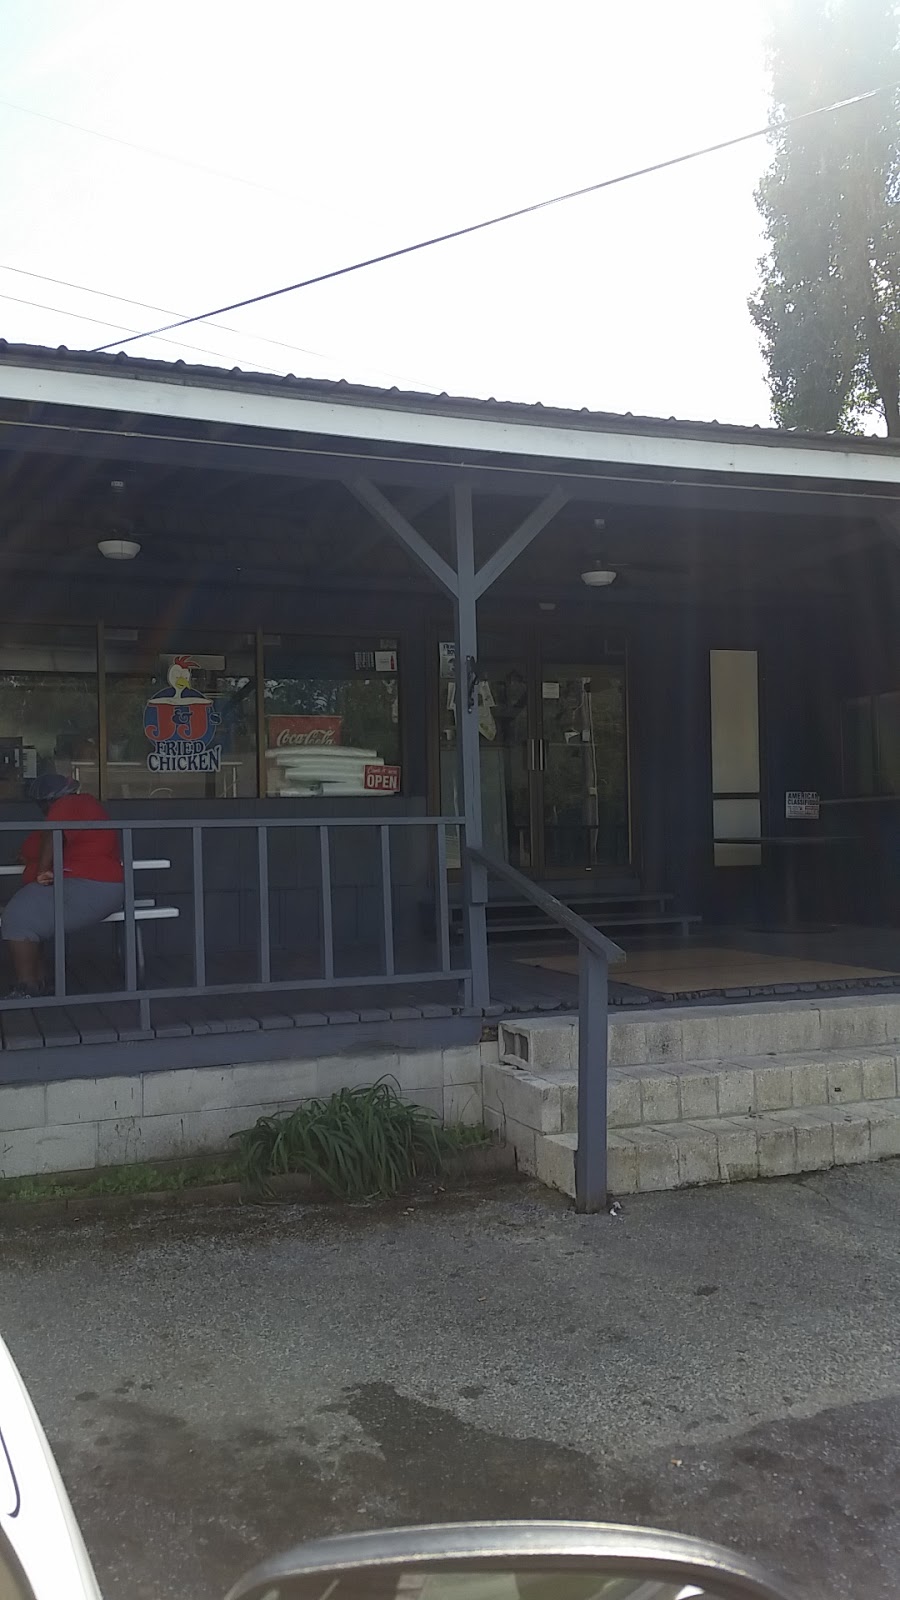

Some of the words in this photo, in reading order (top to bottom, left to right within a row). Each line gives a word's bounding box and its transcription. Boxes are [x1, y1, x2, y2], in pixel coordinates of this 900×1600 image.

[156, 741, 205, 756] FRIED
[148, 745, 221, 771] CHICKEN
[366, 774, 398, 789] OPEN
